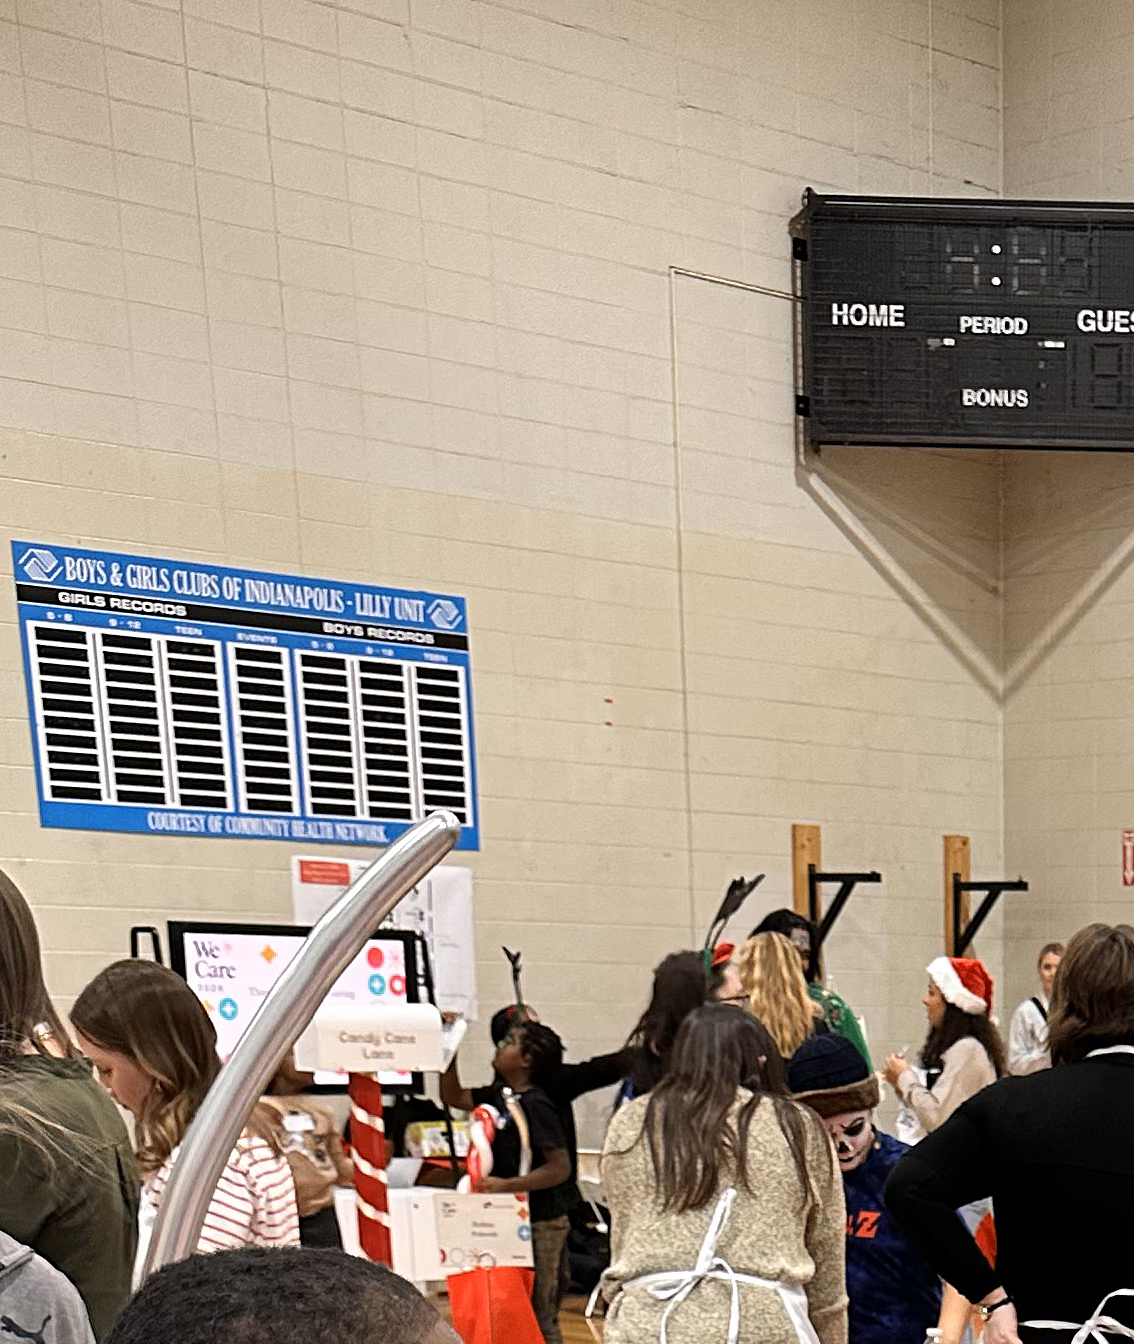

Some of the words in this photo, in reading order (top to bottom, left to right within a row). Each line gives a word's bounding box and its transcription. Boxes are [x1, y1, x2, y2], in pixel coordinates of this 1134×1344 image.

[831, 303, 905, 328] HOME
[960, 316, 1029, 335] PERIOD
[962, 389, 1029, 408] BONUS
[64, 557, 106, 585] BOYS
[110, 563, 123, 587] &
[126, 564, 171, 592] GIRLS
[173, 570, 219, 598] CLUBS
[222, 576, 242, 602] OF
[245, 579, 345, 613] INDIANAPOLIS
[354, 593, 391, 619] LILLY
[394, 598, 425, 623] UNIT
[58, 591, 106, 608] GIRLS
[110, 597, 187, 616] RECORDS
[322, 622, 364, 637] BOYS
[367, 627, 435, 645] RECORDS
[147, 811, 207, 833] COURTESY
[207, 815, 222, 833] OF
[193, 940, 220, 959] We
[194, 960, 236, 979] Care
[339, 1030, 381, 1046] Candy
